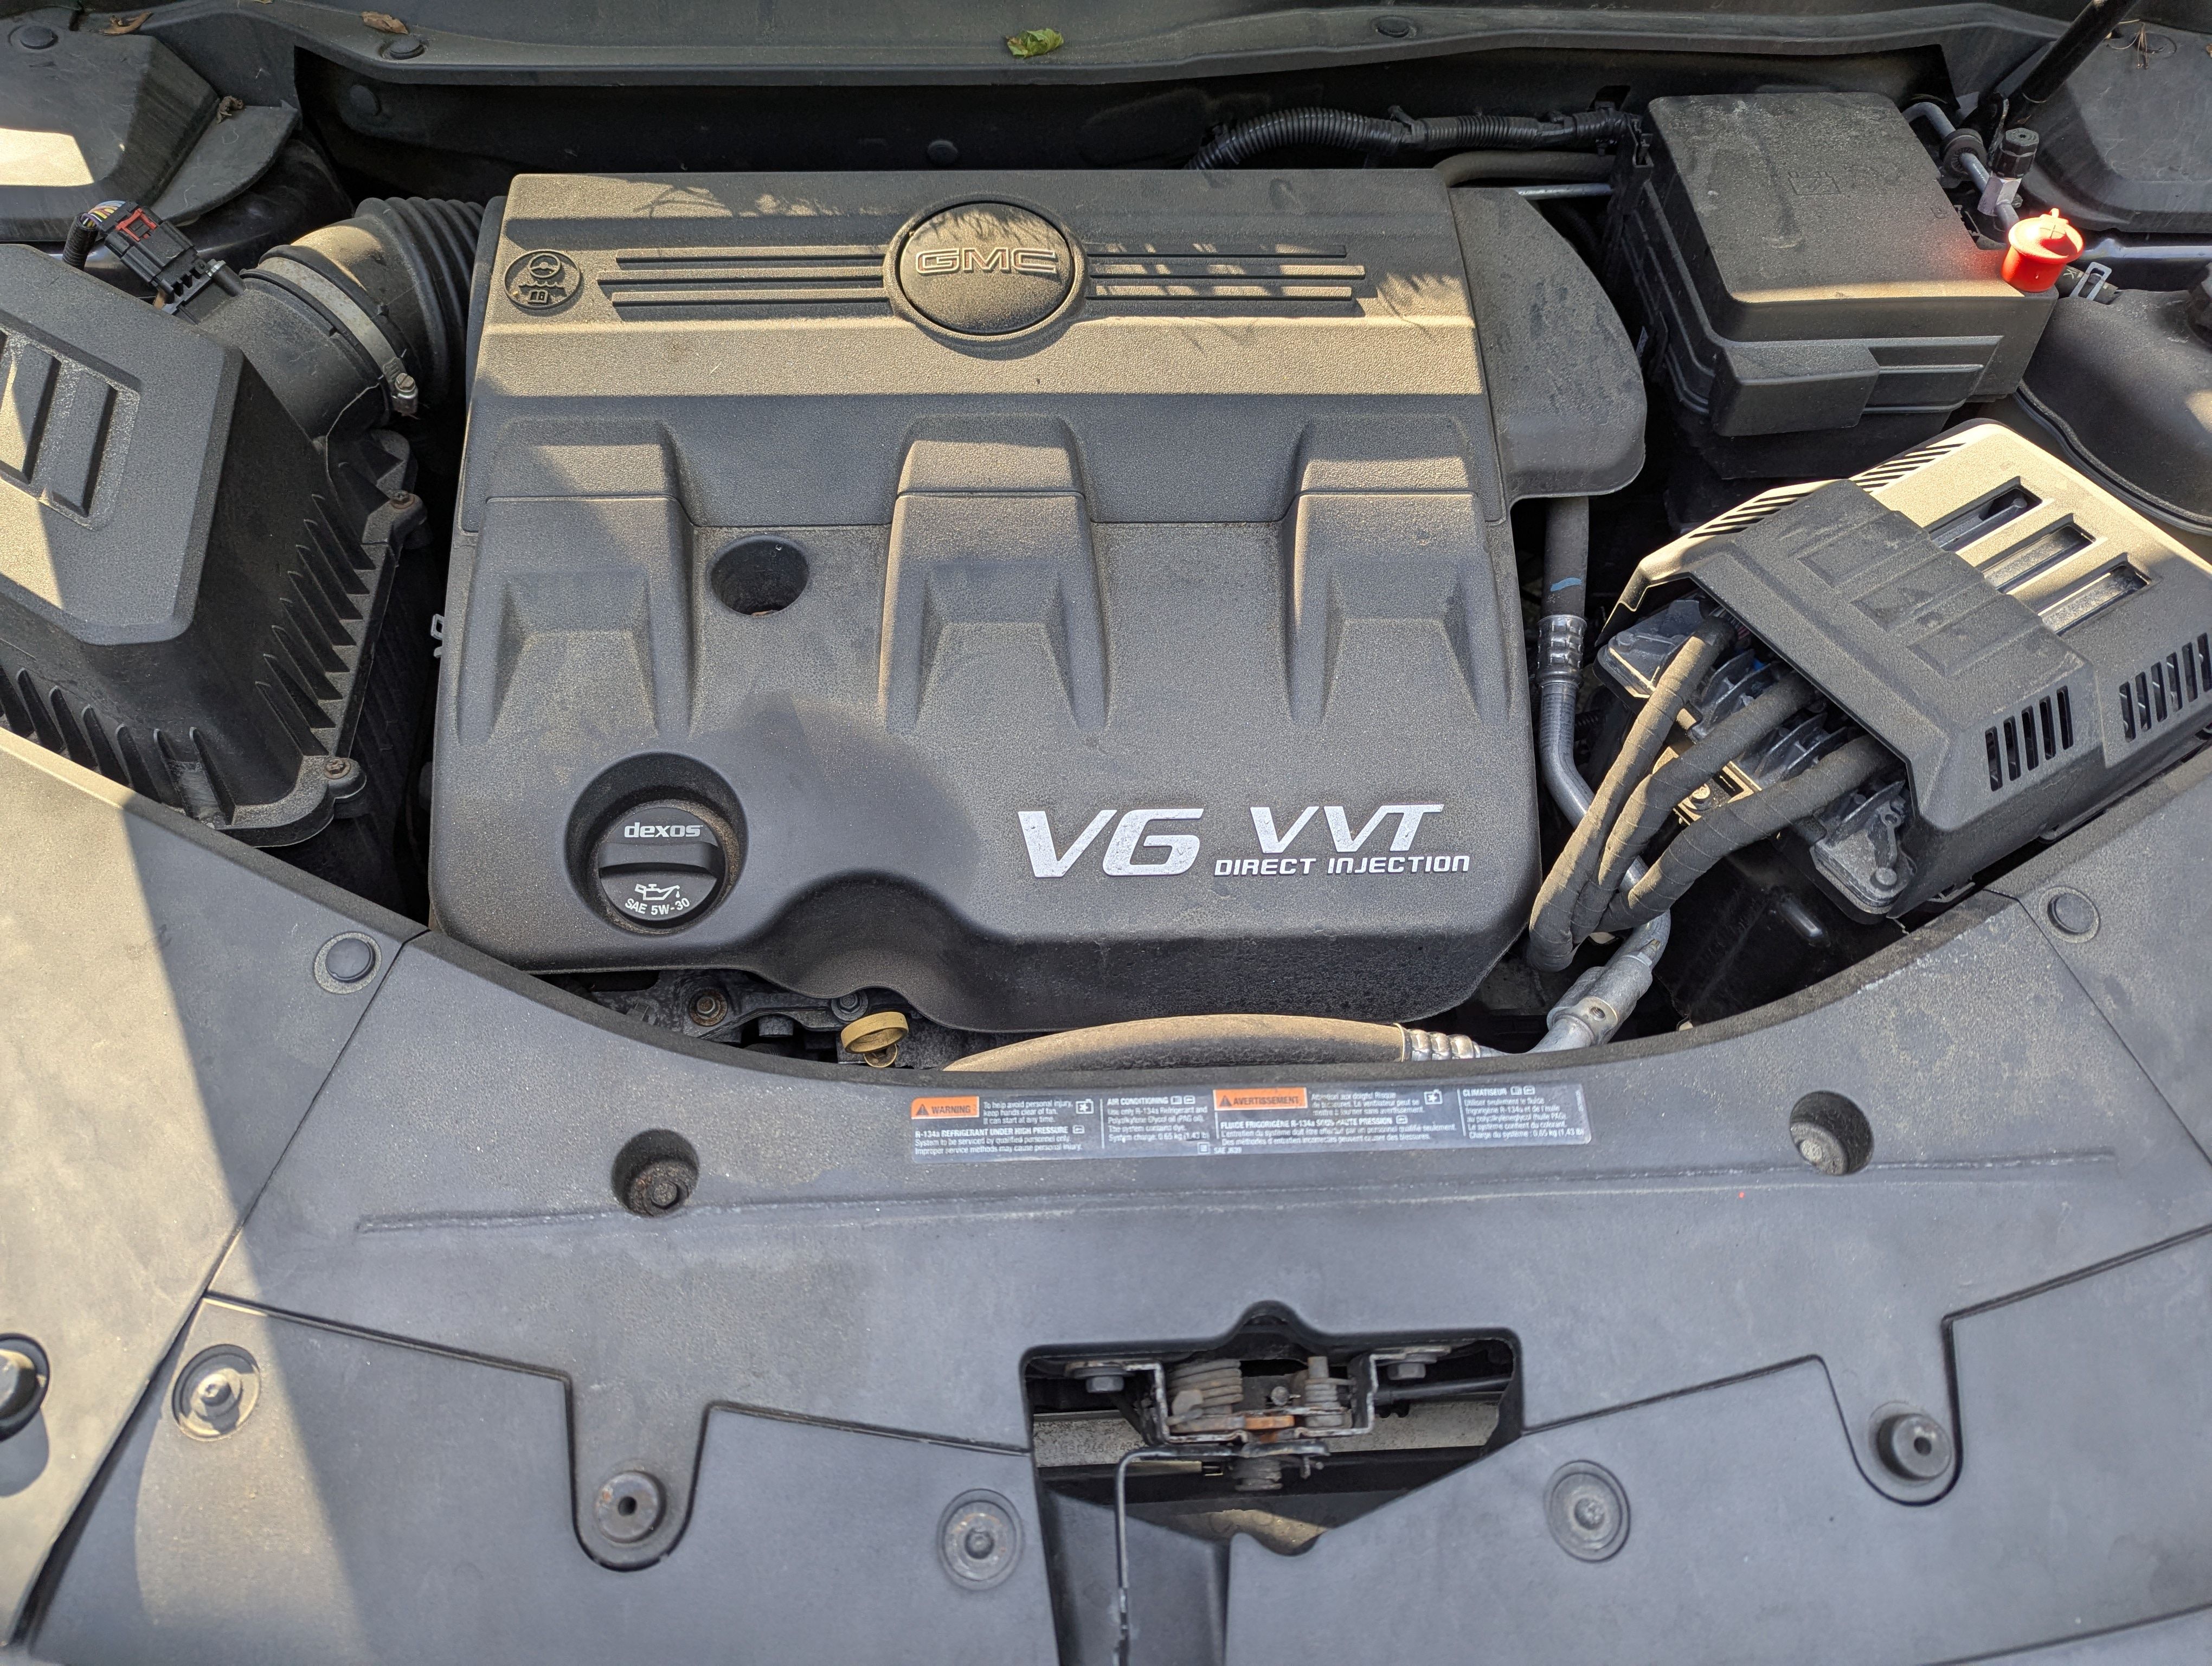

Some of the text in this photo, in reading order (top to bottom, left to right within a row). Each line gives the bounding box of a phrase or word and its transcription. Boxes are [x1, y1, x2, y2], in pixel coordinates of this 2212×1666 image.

[915, 247, 1058, 274] GMC
[1018, 804, 1445, 877] V6 VVT
[1214, 856, 1470, 877] DIRECT INJECTION
[625, 898, 690, 915] SAE 5W-30
[931, 1106, 970, 1114] WARNING
[1233, 1097, 1299, 1105] AVERTISSEMENT
